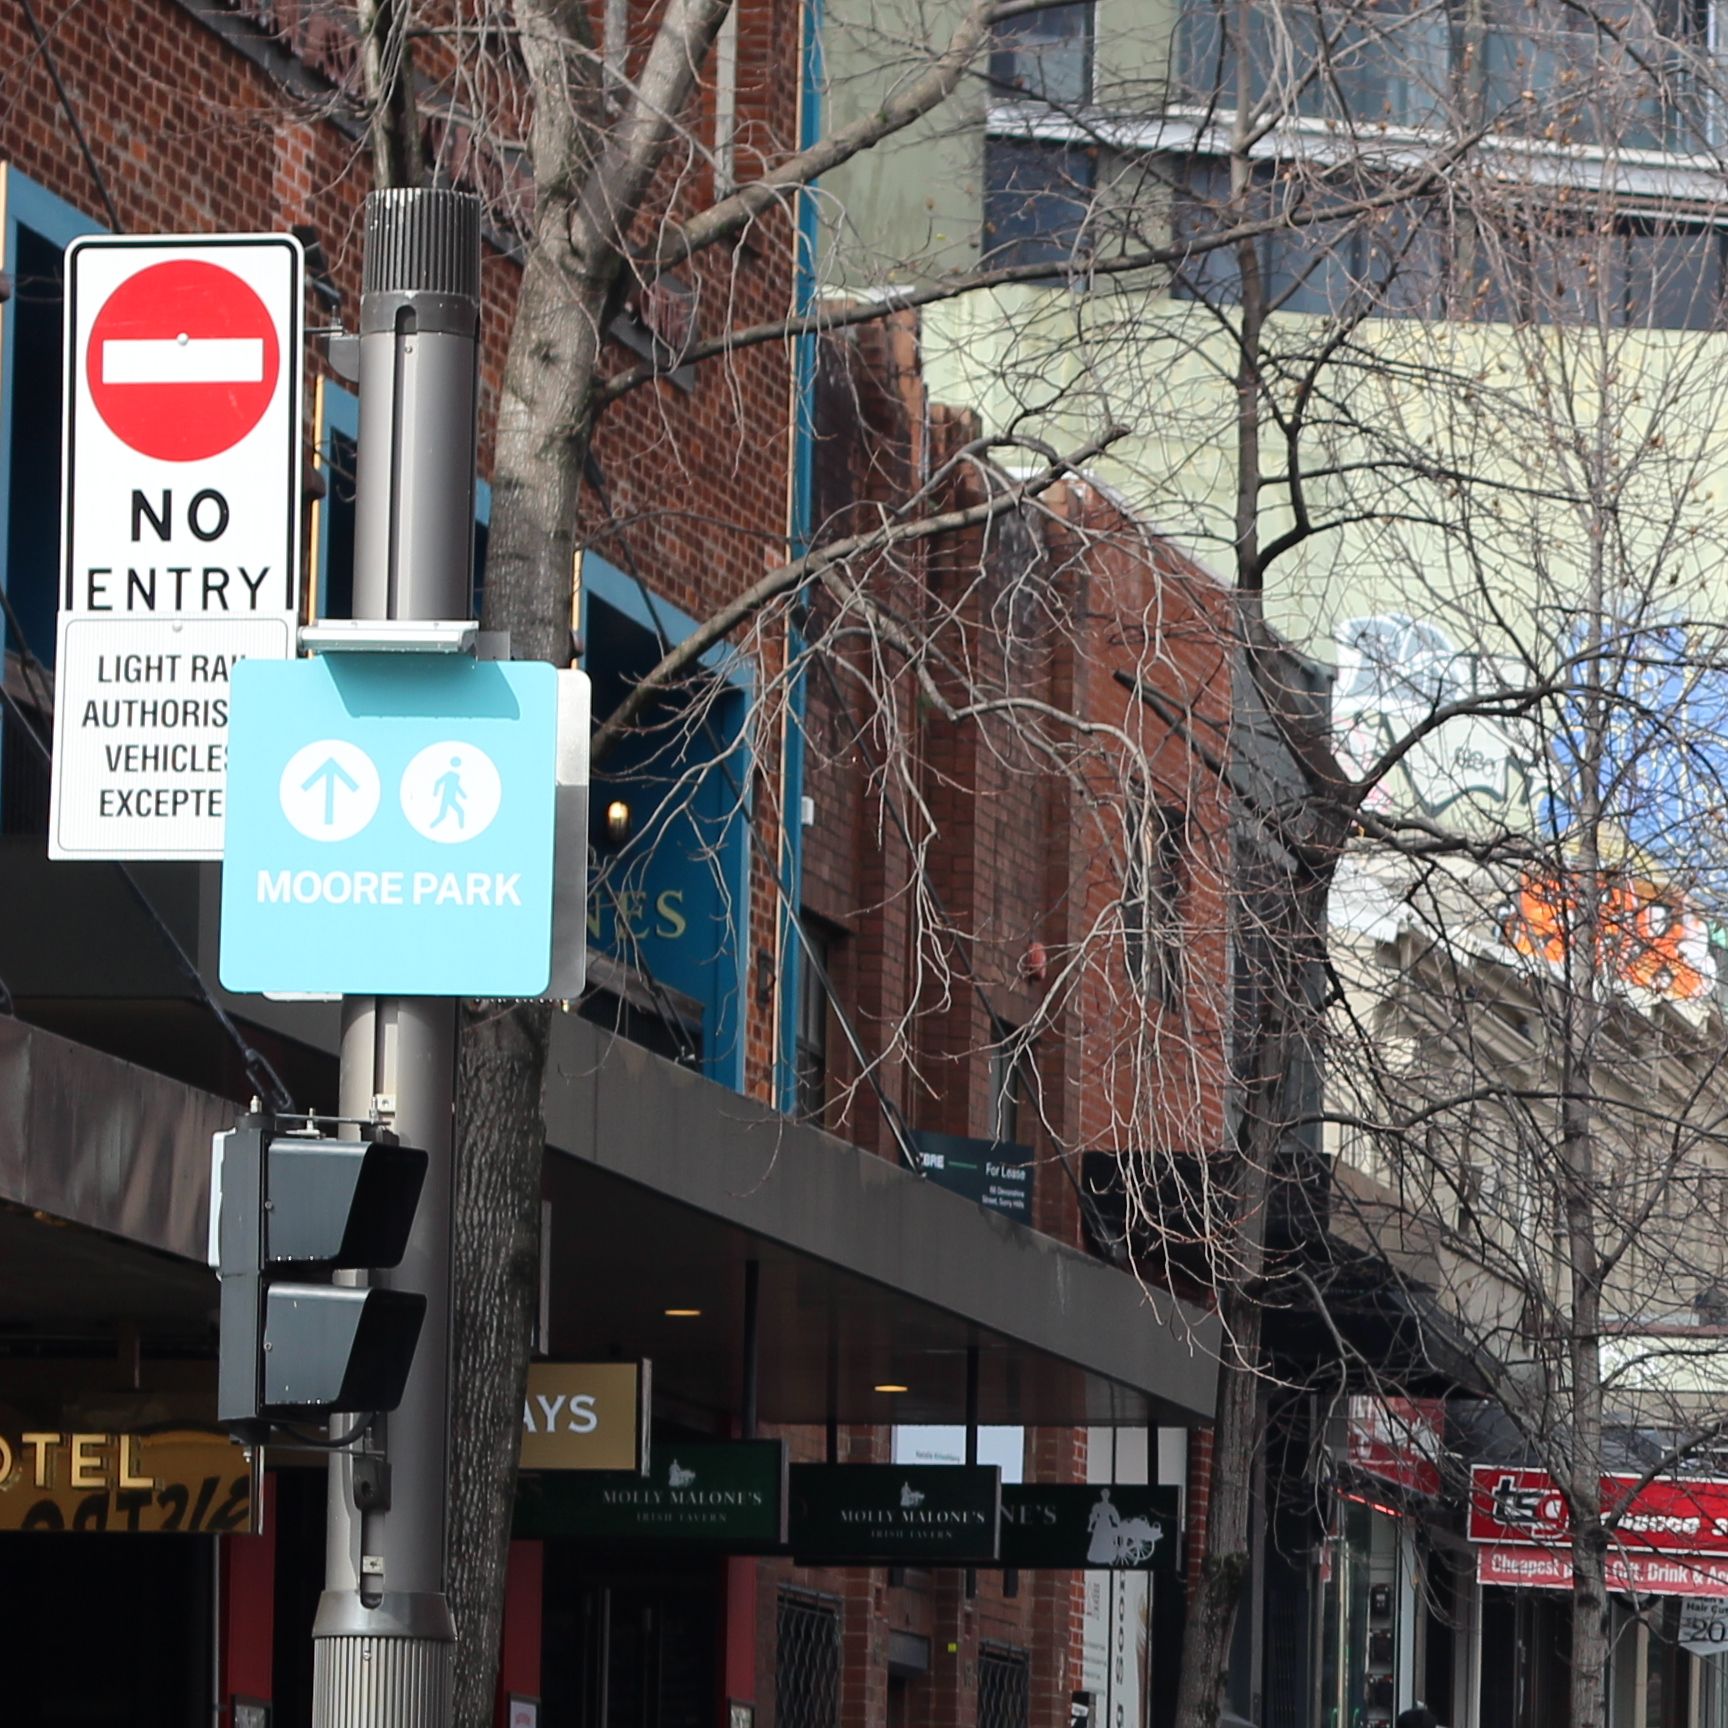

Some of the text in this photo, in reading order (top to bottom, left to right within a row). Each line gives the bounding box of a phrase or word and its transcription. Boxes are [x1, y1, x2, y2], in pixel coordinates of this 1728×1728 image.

[130, 488, 230, 542] NO
[87, 567, 271, 611] ENTRY
[98, 655, 182, 683] LIGHT
[82, 699, 229, 728] AUTHORIS
[105, 744, 229, 773] VEHICLE
[100, 789, 223, 818] EXCEPTE
[256, 870, 523, 907] MOORE PARK
[986, 1162, 1000, 1177] For
[1001, 1165, 1026, 1181] Lease
[602, 1490, 763, 1506] MOLLY MALONE'S
[636, 1512, 728, 1524] IRISH TAVERN
[841, 1510, 986, 1525] MOLLY MALONE'S
[871, 1529, 953, 1540] IRISH TAVERN
[1492, 1554, 1560, 1580] Cheapest
[1648, 1563, 1689, 1585] Drink
[1693, 1566, 1703, 1586] &
